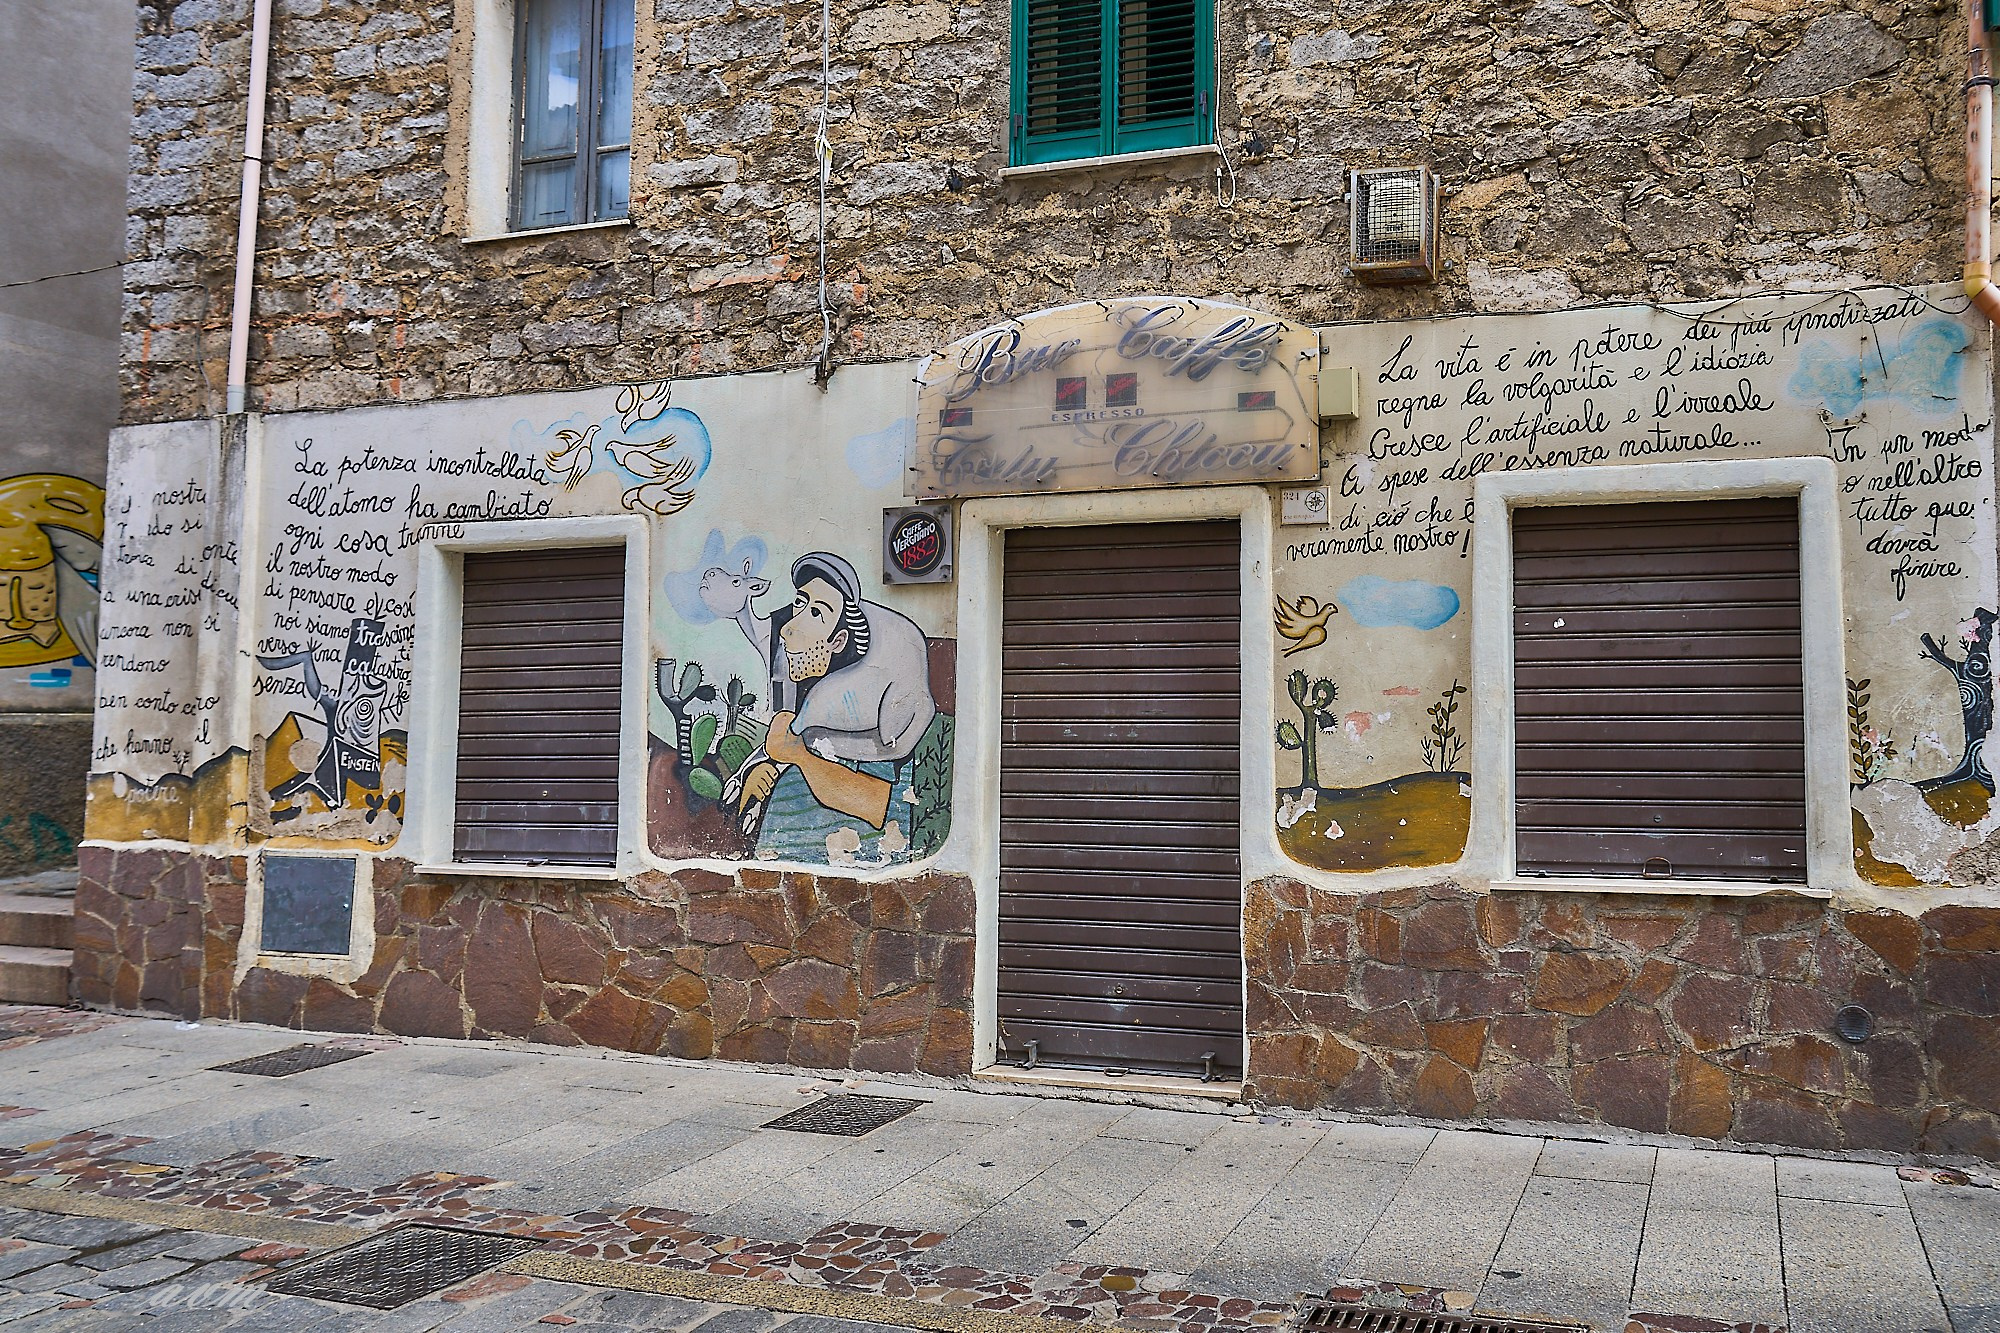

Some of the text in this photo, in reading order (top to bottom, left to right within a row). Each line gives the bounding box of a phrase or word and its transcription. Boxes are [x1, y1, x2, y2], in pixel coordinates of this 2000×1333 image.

[940, 323, 1080, 403] Bar
[1378, 334, 1418, 384] La
[1435, 334, 1484, 379] vita
[1523, 341, 1558, 370] in
[1569, 323, 1662, 371] potere
[1682, 314, 1726, 342] dei
[1376, 392, 1447, 429] regna
[1460, 379, 1494, 410] la
[1627, 366, 1651, 381] e
[1659, 343, 1774, 377] l'idiozia
[1051, 408, 1145, 422] ESPRESSO
[1368, 378, 1775, 460] Cresce l'artificiale e l'irreale
[294, 438, 550, 486] La potenza incontrollata
[1881, 434, 1914, 464] un
[1378, 466, 1429, 506] spese
[1439, 444, 1610, 482] dell'essenza
[1841, 453, 1983, 493] o nell'altro
[287, 481, 553, 521] dell'atomo ha cambiato
[1415, 496, 1455, 523] che
[1849, 492, 1918, 535] tutto
[284, 522, 465, 557] ogni cosa tranne
[892, 523, 936, 555] VERGNANO
[902, 535, 937, 569] 1882
[1866, 529, 1939, 554] dovrà
[175, 556, 197, 574] di
[265, 543, 398, 586] il nostro modo
[126, 590, 163, 606] una
[200, 571, 217, 592] di
[263, 577, 284, 599] di
[288, 585, 356, 613] pensare
[100, 612, 220, 640] ancora non si
[274, 611, 301, 630] noi
[305, 615, 350, 639] siamo
[100, 653, 170, 673] rendono
[258, 637, 301, 655] verso
[100, 688, 128, 709] ben
[134, 688, 179, 714] conto
[253, 675, 306, 698] senza
[95, 719, 211, 761] che hanno il
